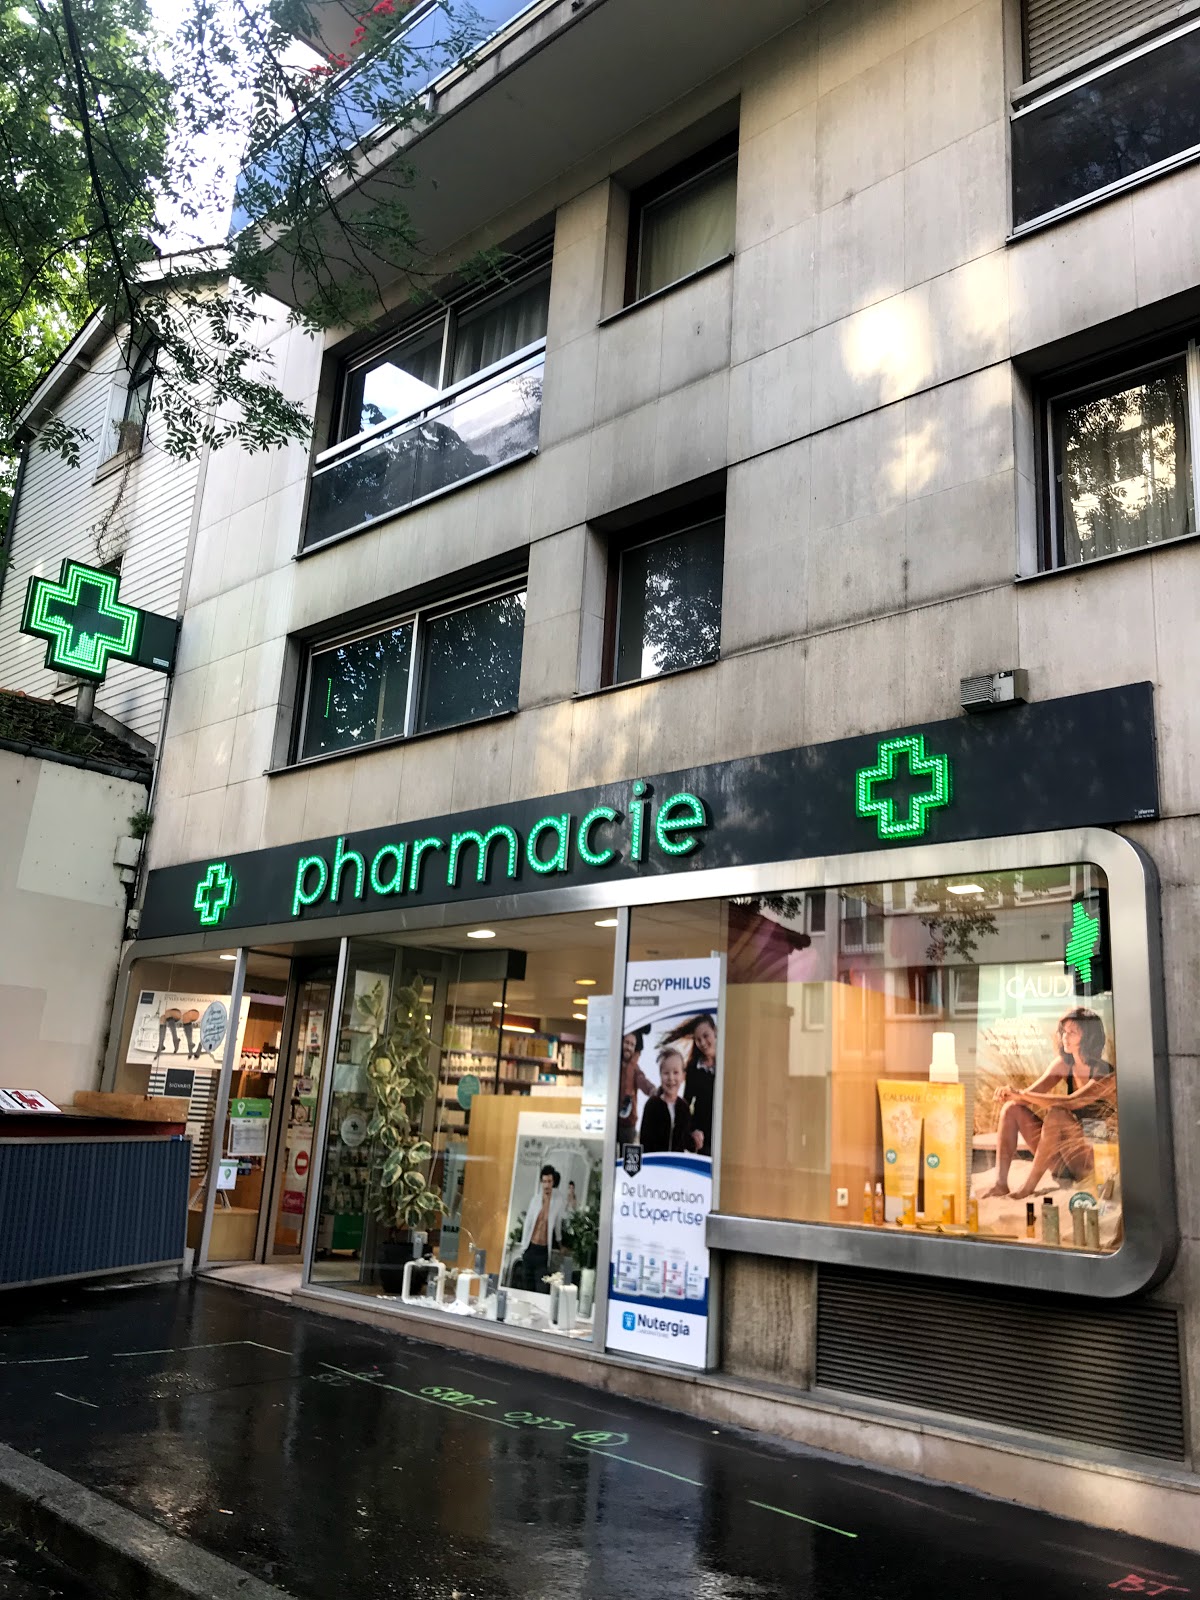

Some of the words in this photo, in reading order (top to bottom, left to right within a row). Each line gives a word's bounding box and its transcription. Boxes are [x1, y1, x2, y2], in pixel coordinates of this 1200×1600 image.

[292, 779, 707, 916] pharmacie
[633, 976, 711, 992] ERGYPHILUS
[621, 1182, 636, 1197] De
[620, 1202, 630, 1217] à
[632, 1202, 704, 1226] l'Expertise
[637, 1313, 690, 1337] Nutergia
